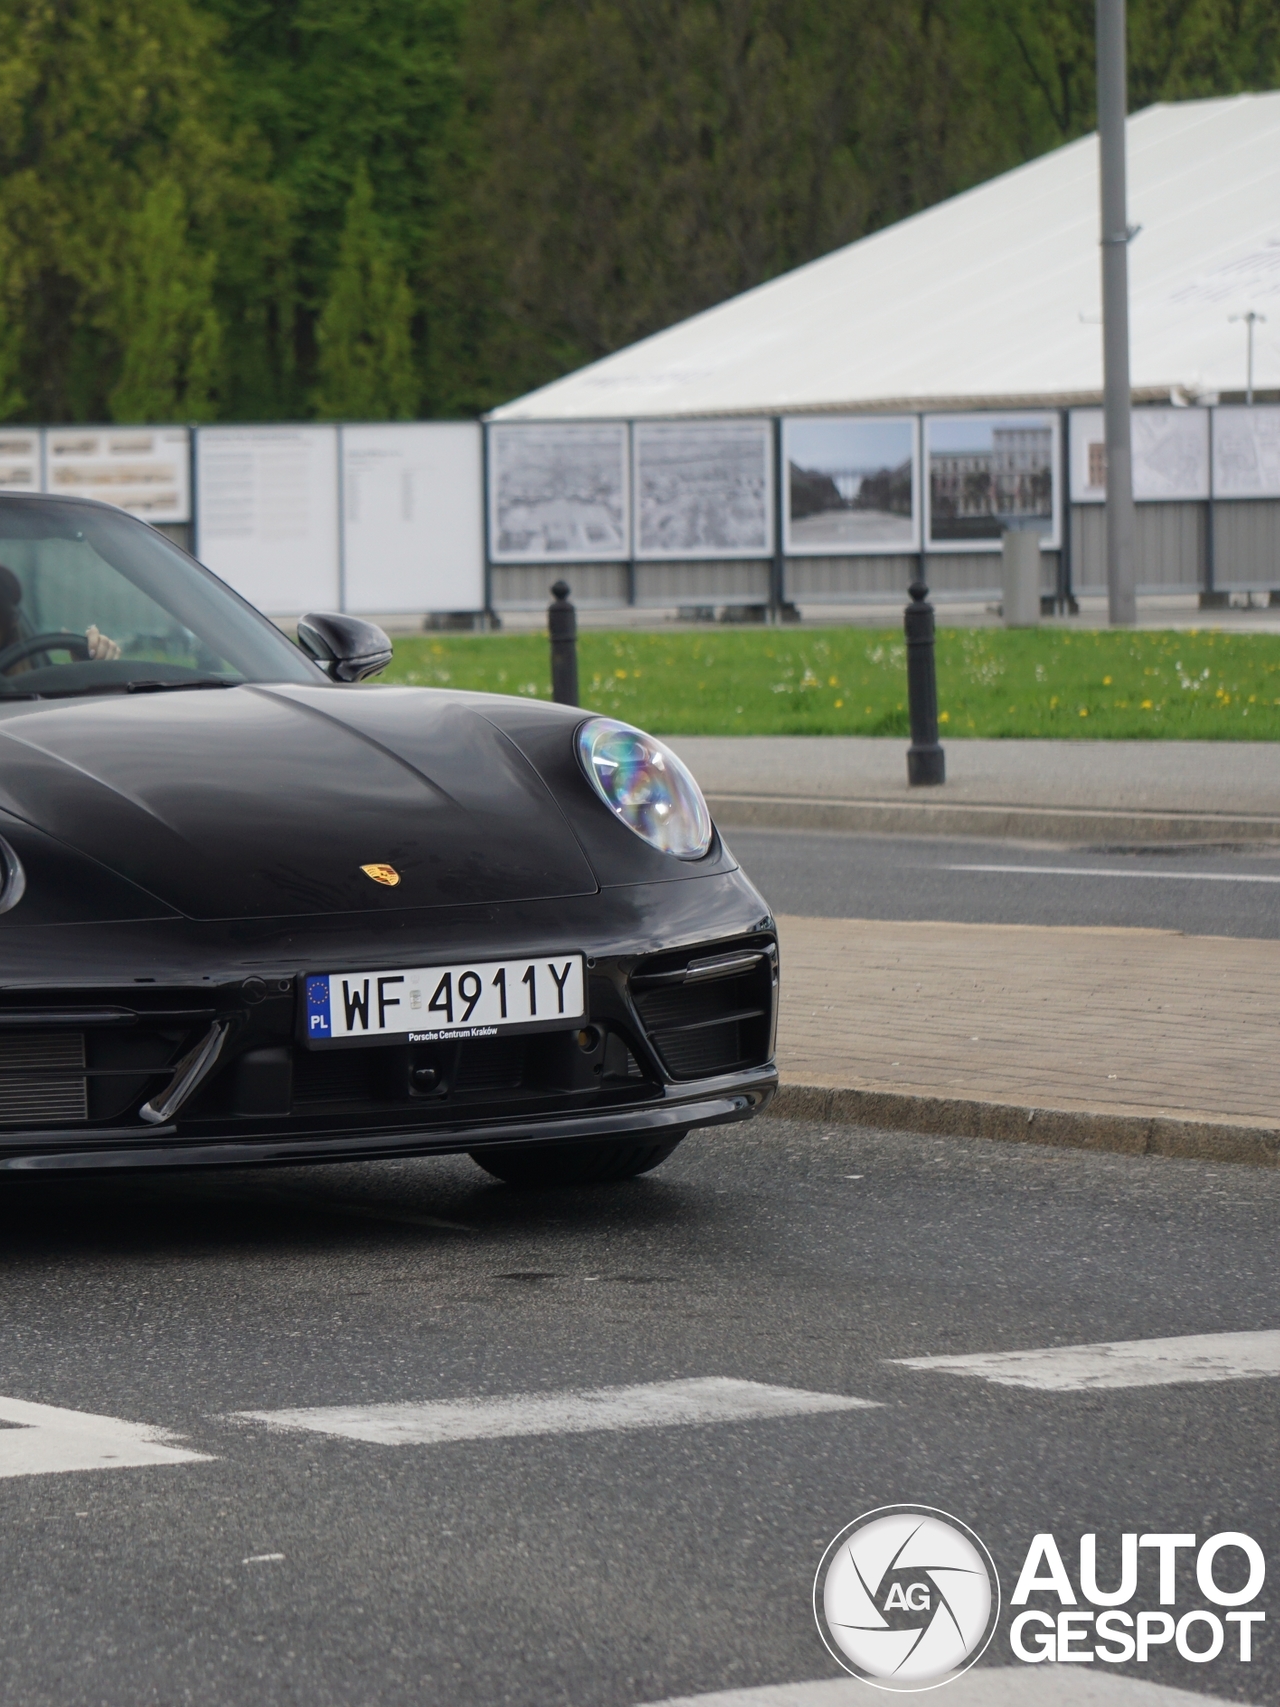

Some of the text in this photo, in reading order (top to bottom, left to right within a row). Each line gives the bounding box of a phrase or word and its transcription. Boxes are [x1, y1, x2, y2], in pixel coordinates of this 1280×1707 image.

[342, 962, 572, 1031] WF 4911Y
[310, 1015, 328, 1030] PL
[408, 1026, 498, 1042] Porsche Centrum Kraków
